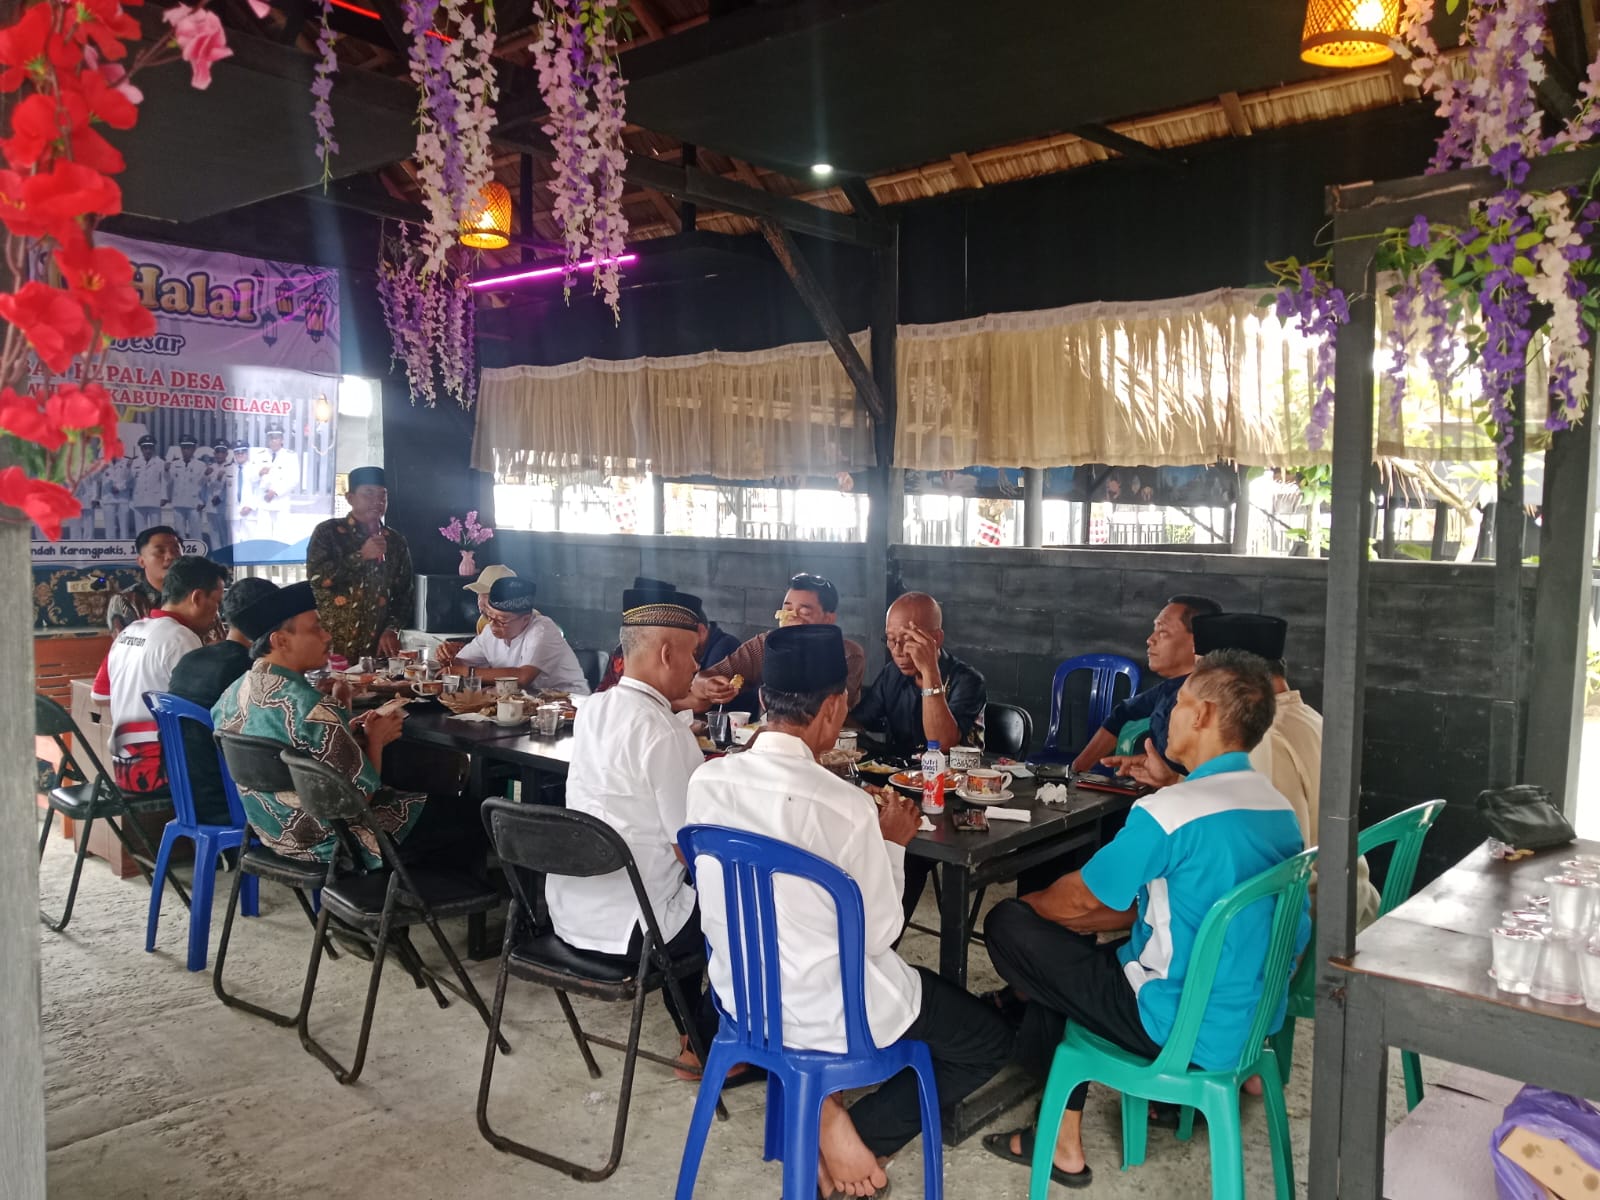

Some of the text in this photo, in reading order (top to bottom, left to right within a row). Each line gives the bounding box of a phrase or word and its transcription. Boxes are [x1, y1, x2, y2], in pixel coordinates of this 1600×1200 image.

[170, 371, 226, 392] DESA
[221, 397, 292, 415] CILACAP
[60, 545, 127, 559] Karangpakis,
